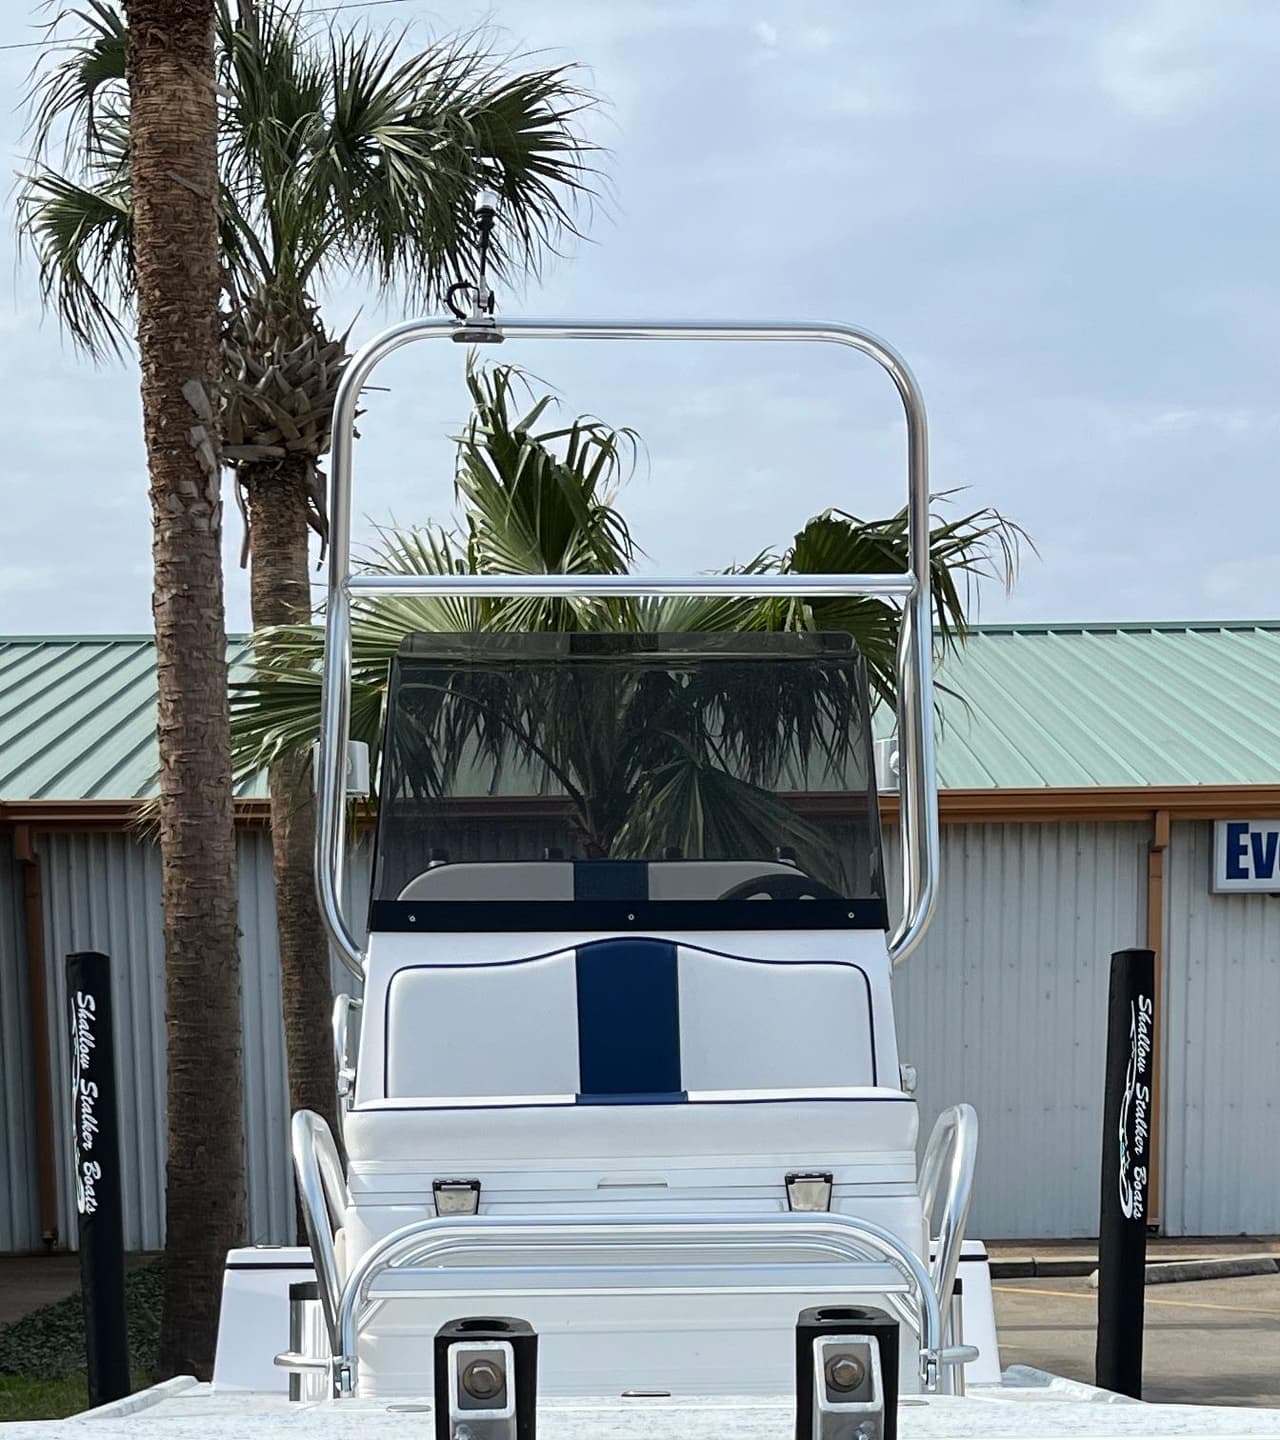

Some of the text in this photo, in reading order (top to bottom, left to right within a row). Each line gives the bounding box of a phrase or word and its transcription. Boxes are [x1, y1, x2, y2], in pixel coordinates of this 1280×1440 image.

[76, 991, 102, 1215] Shallow Stalker Boats
[1133, 994, 1153, 1219] Shallow Stalker Boats
